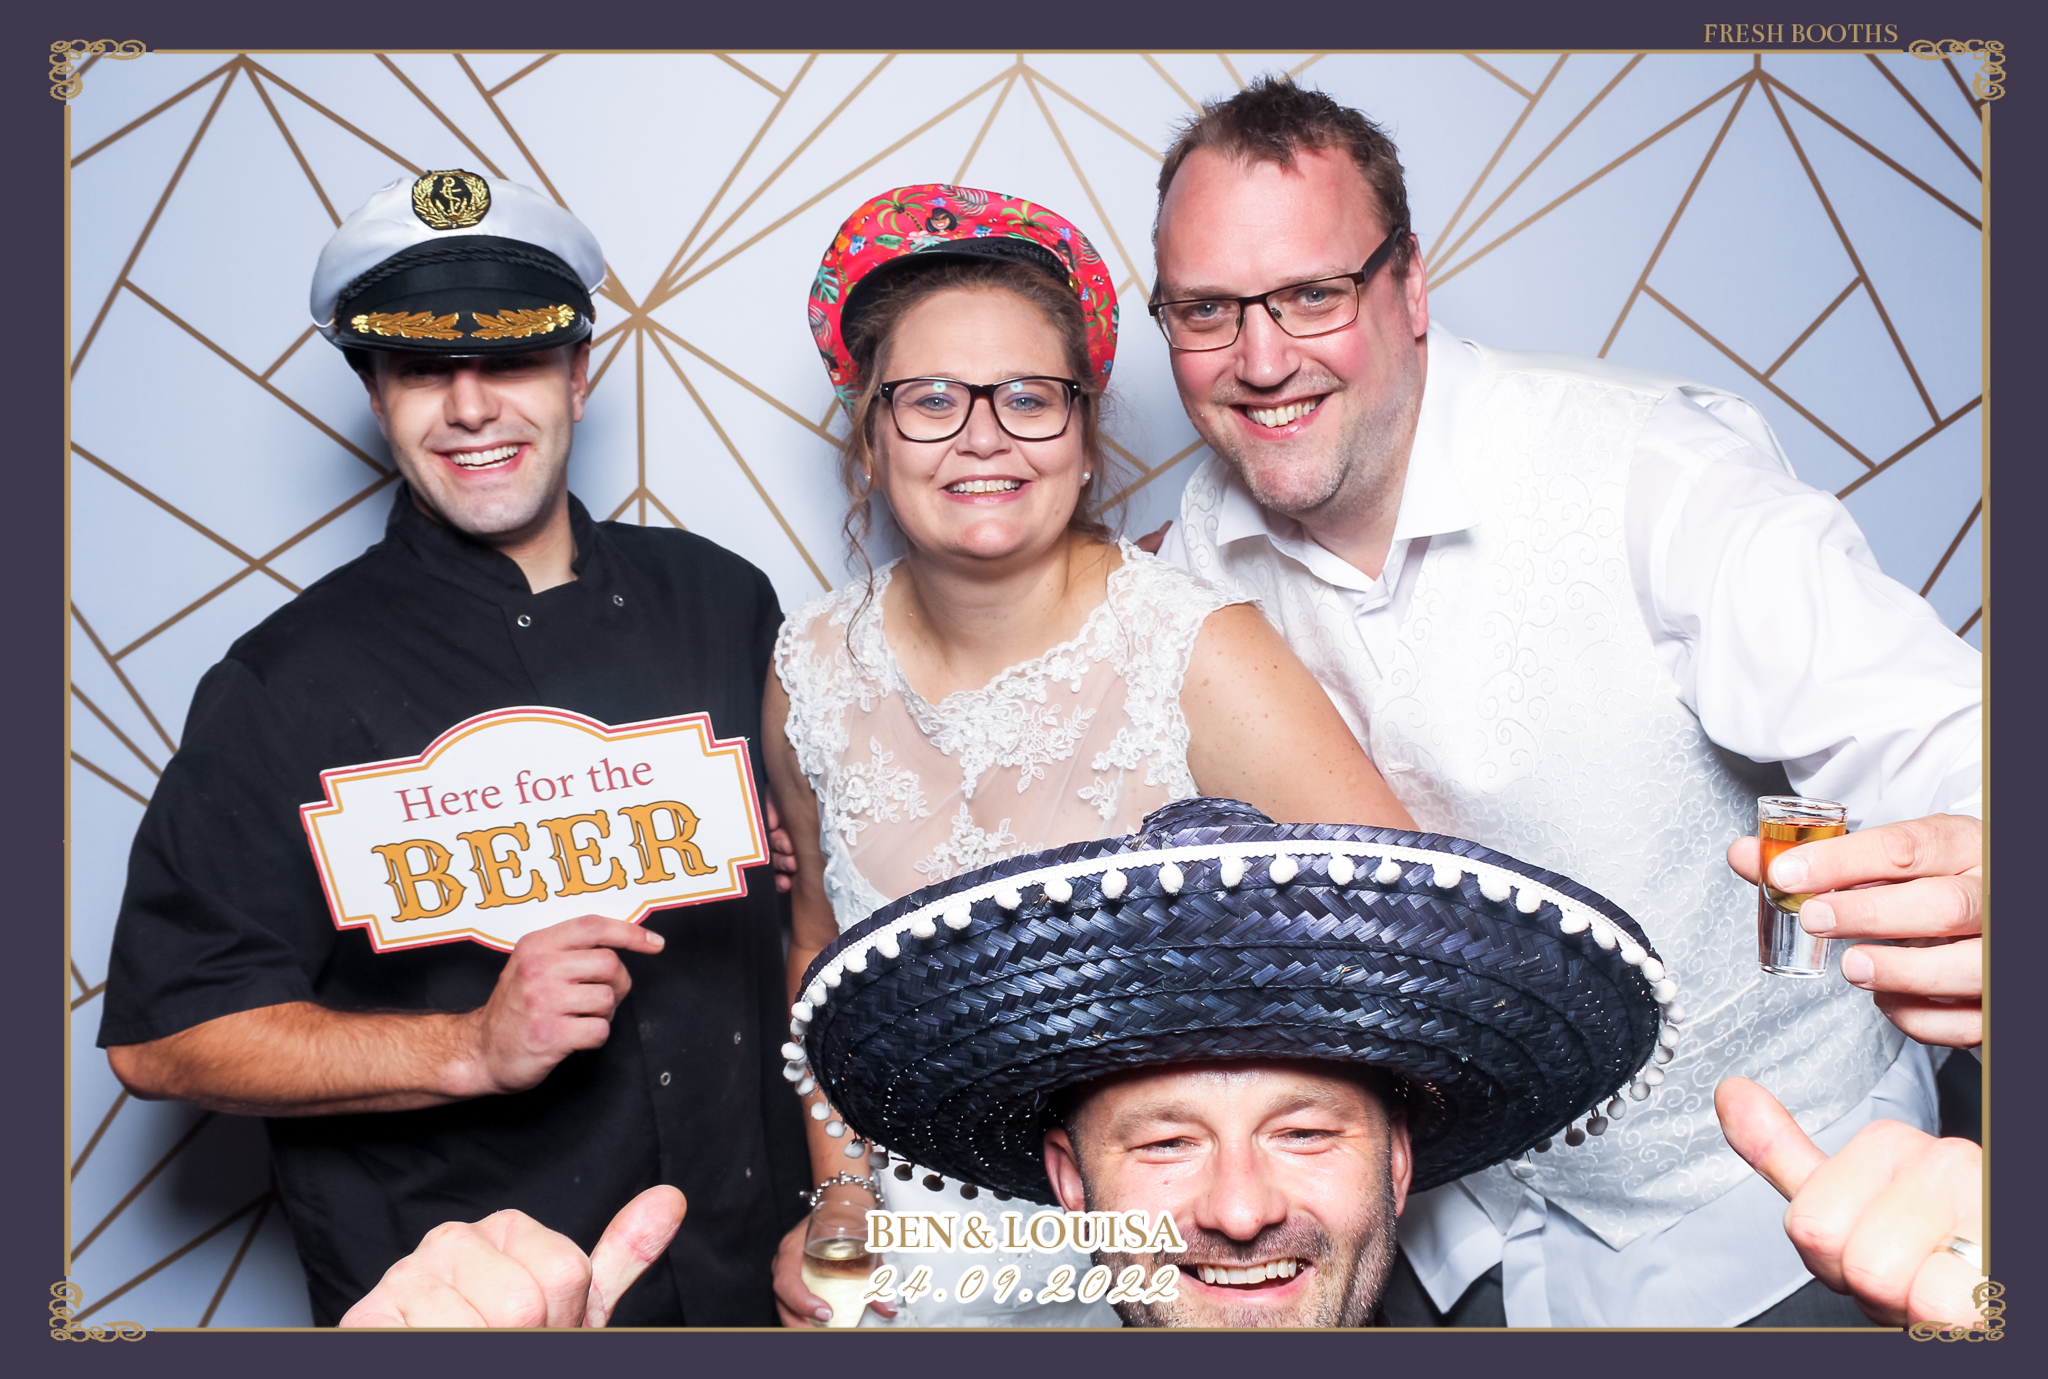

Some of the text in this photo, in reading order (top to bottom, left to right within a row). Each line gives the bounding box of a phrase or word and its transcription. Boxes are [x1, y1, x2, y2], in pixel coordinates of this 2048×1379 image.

[394, 758, 655, 822] Here for the
[371, 800, 718, 923] BEER
